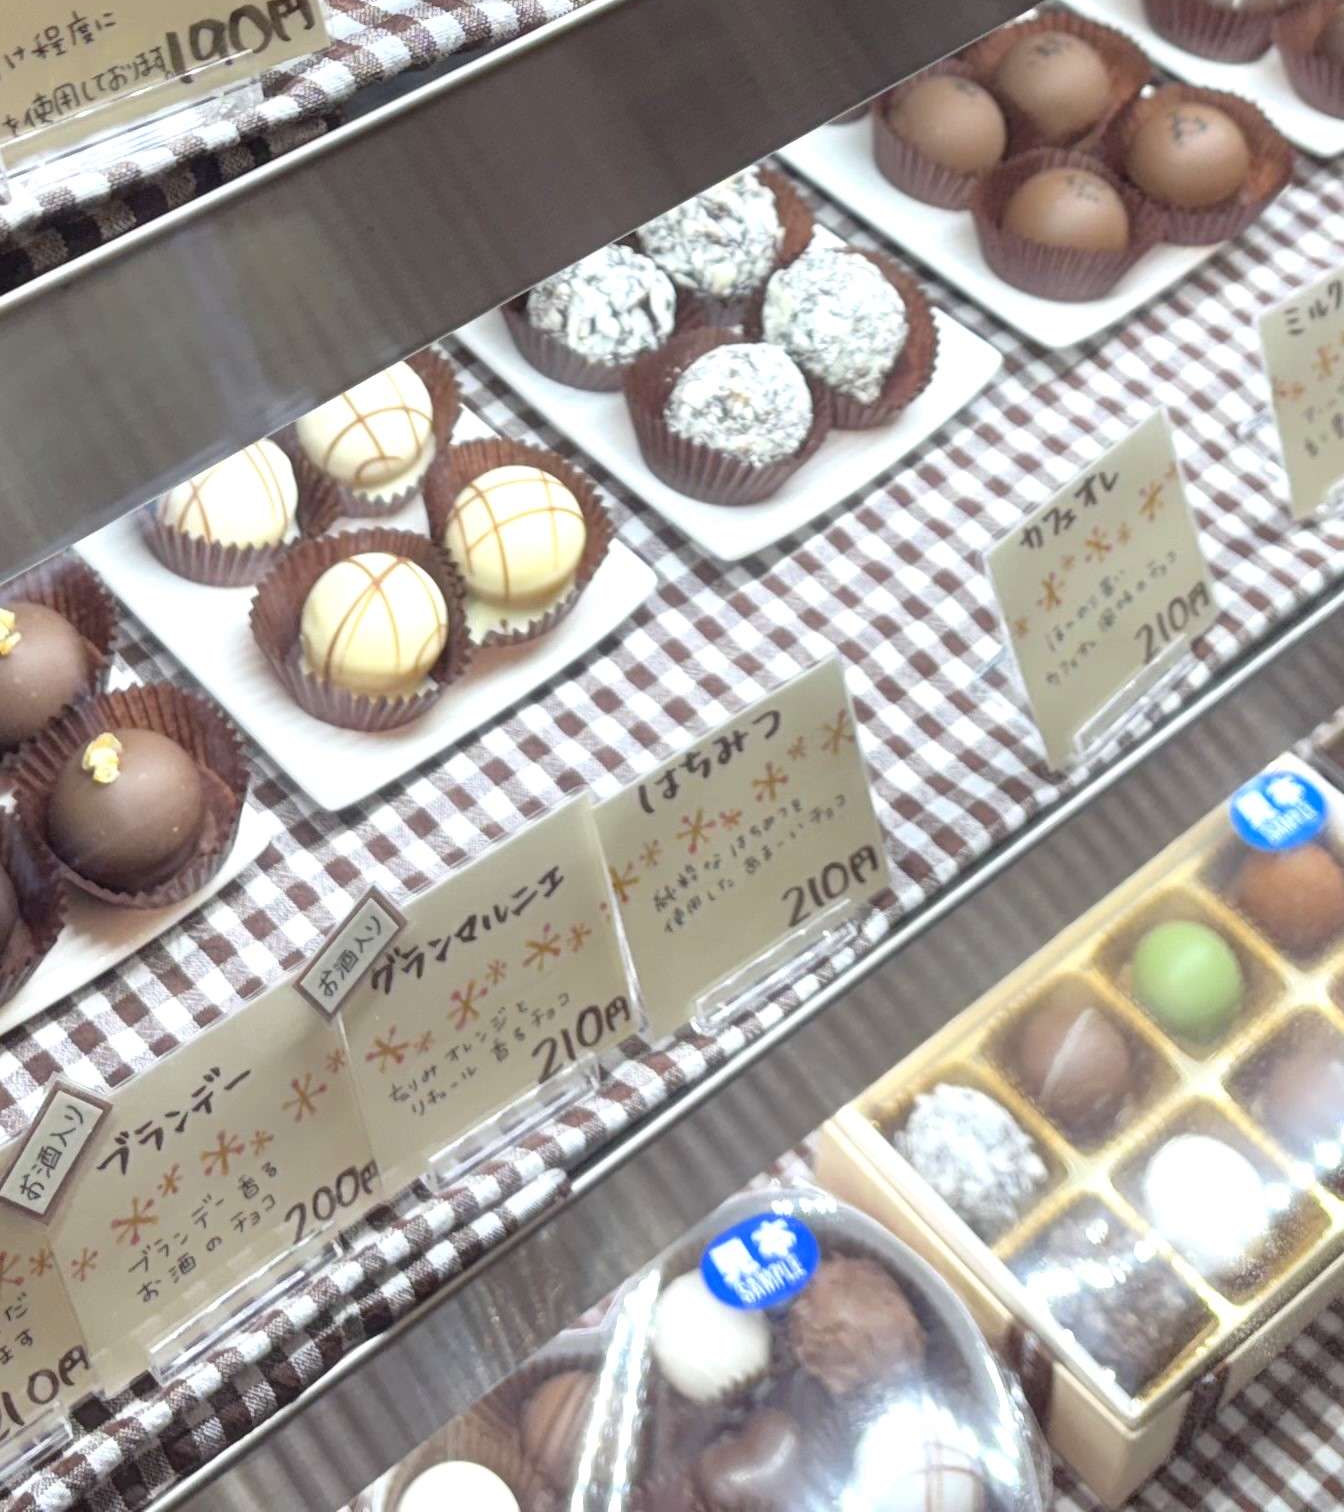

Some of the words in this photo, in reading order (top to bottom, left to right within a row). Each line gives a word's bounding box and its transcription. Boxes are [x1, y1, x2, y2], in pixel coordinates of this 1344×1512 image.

[1019, 470, 1120, 552] カフェオレ
[1134, 580, 1212, 665] 210円
[637, 709, 782, 814] はちみつ
[371, 865, 566, 995] グランマルニエ
[781, 844, 879, 928] 210円
[317, 914, 383, 998] お酒入り
[531, 996, 631, 1085] 210円
[18, 1104, 86, 1201] お酒入り
[96, 1066, 253, 1176] ブランデー
[283, 1159, 380, 1246] 200円
[136, 1195, 278, 1304] お酒のチョコ
